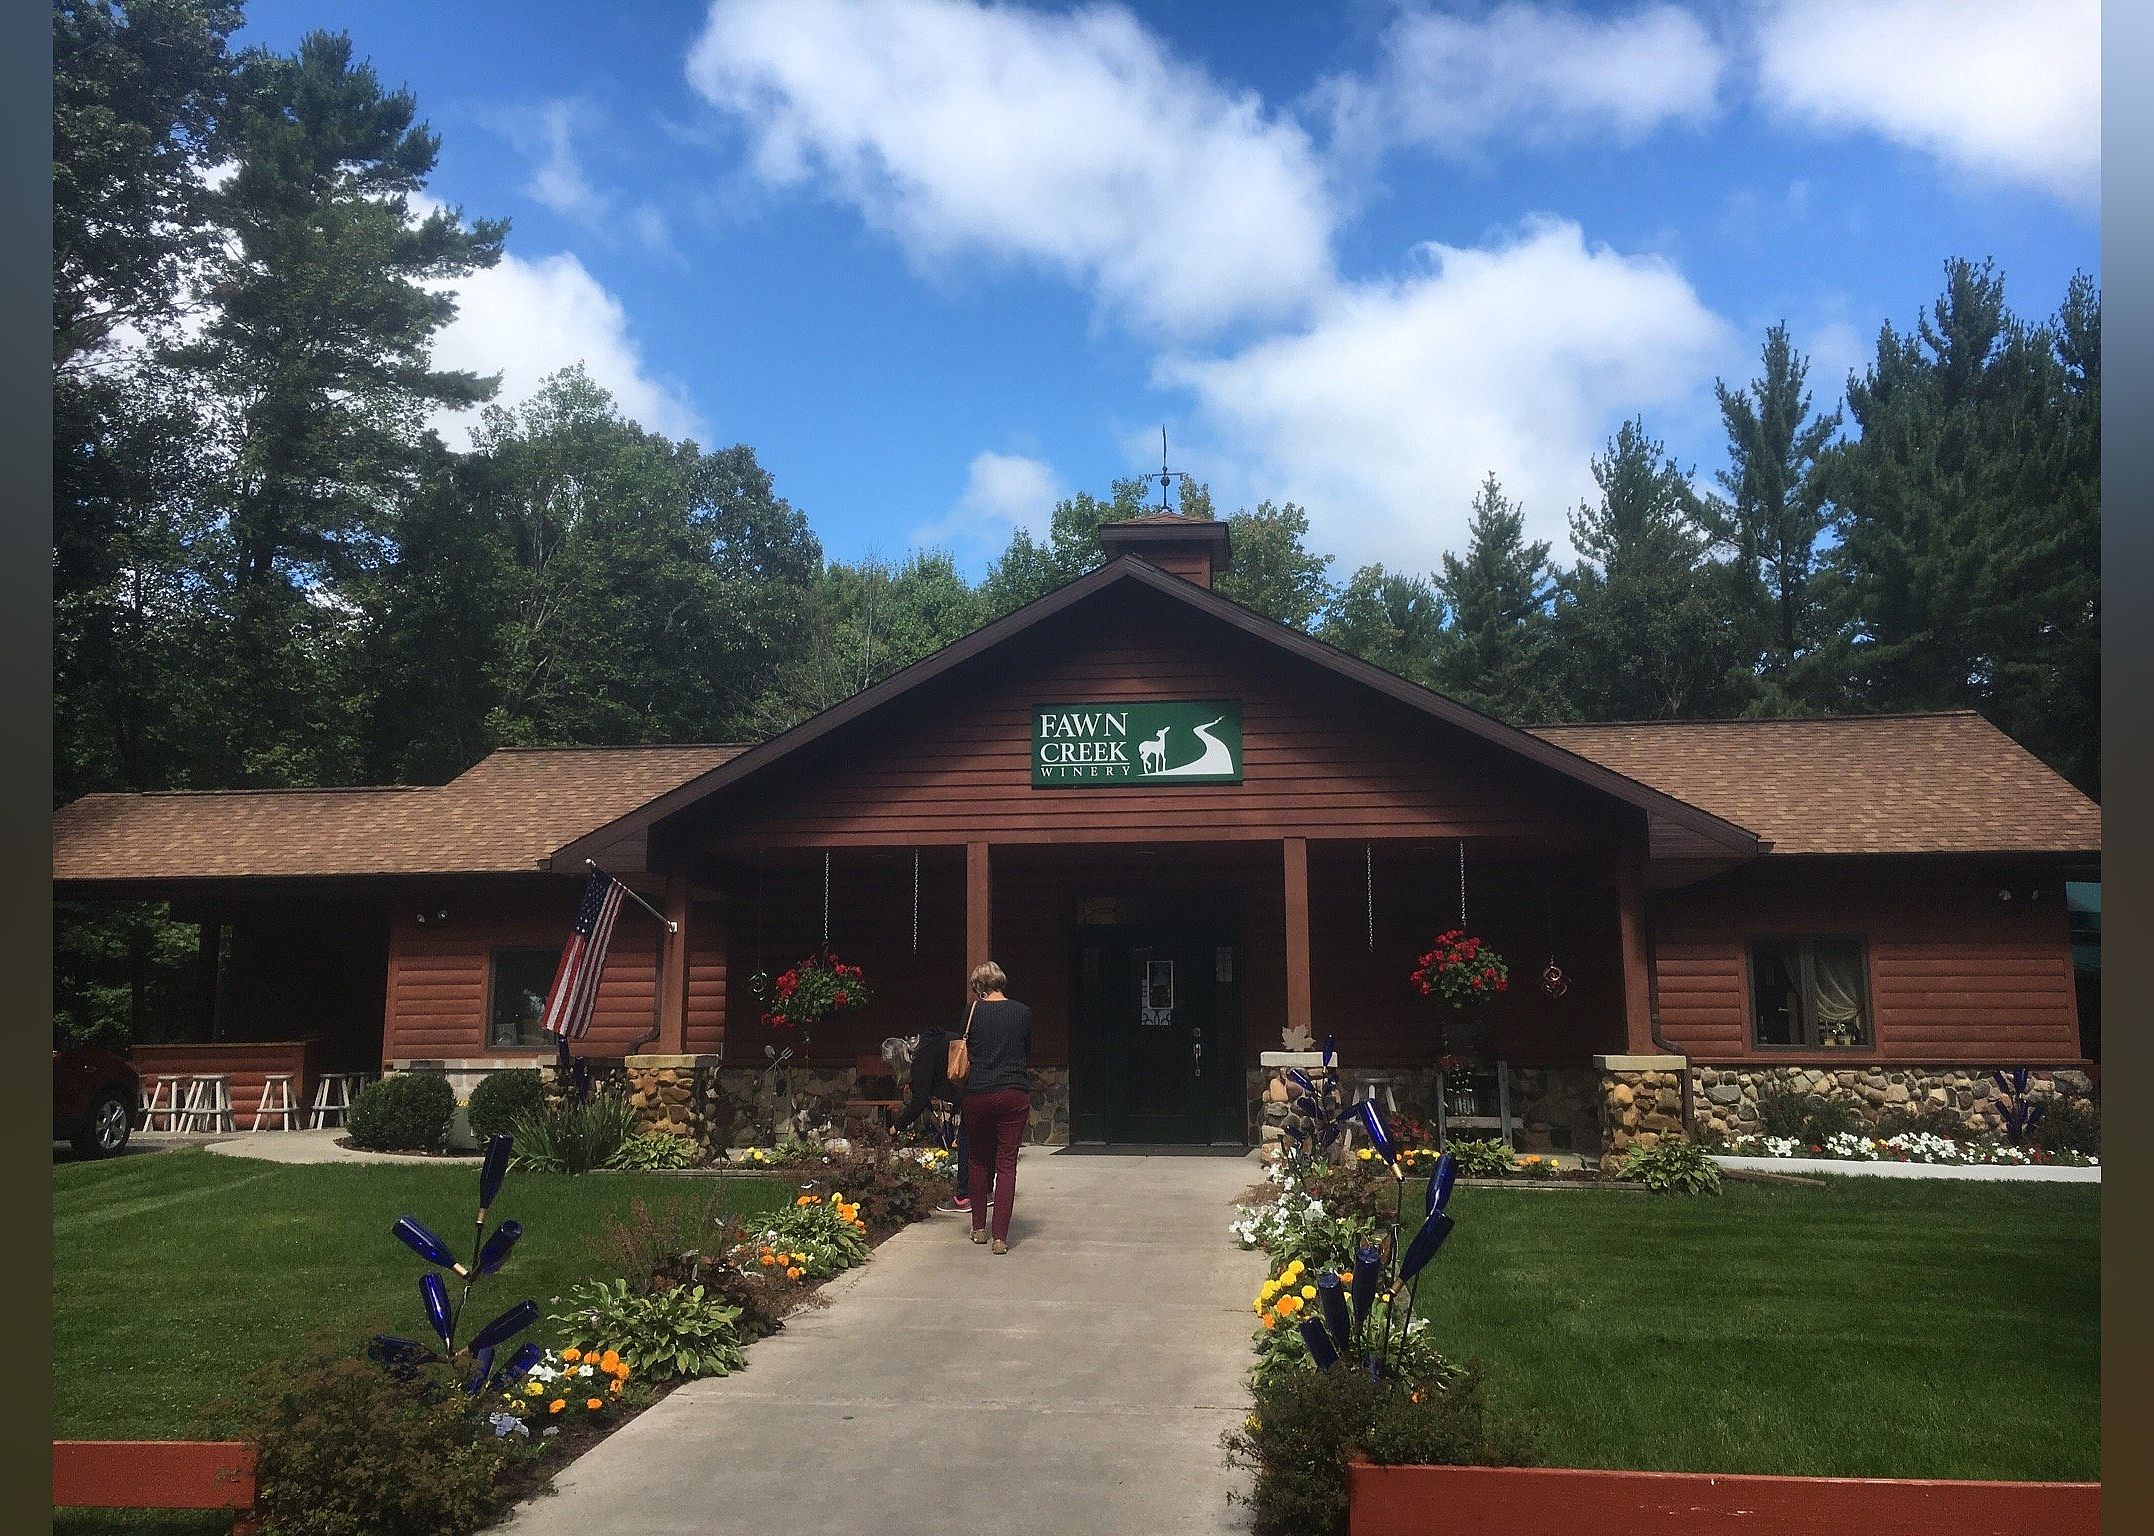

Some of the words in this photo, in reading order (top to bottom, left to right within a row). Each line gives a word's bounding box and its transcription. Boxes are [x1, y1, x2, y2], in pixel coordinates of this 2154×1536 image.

[1039, 712, 1129, 738] FAWN
[1040, 741, 1129, 763] CREEK
[1041, 766, 1131, 777] WINERY
